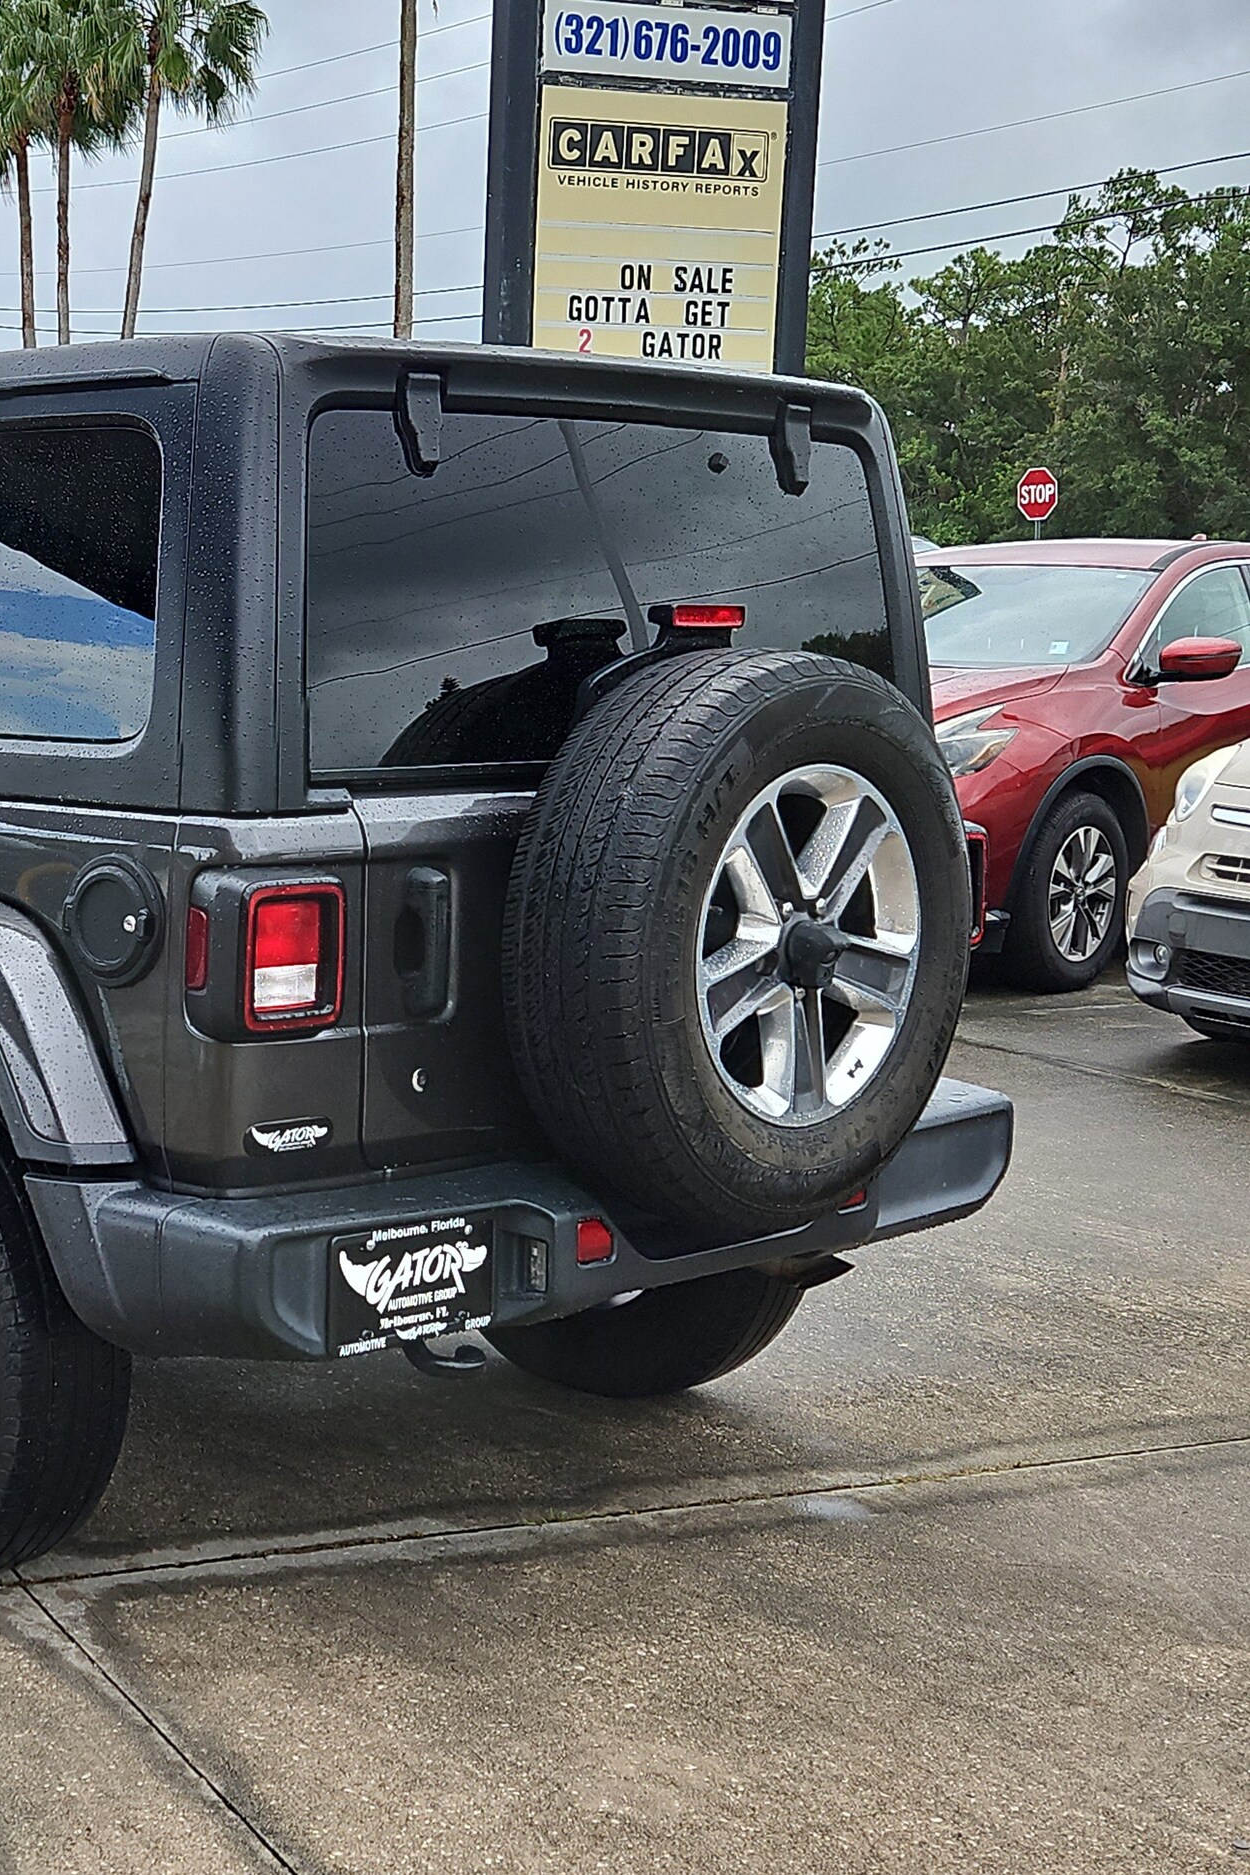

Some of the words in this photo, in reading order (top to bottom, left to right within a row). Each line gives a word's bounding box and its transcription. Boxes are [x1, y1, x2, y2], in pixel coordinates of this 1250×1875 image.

[554, 11, 782, 71] (321)676-2009
[558, 127, 761, 178] CARFAX
[557, 174, 619, 189] VEHICLE
[625, 178, 689, 193] HISTORY
[695, 183, 760, 197] REPORTS
[620, 264, 652, 291] ON
[673, 266, 734, 294] SALE
[568, 295, 651, 325] GOTTA
[684, 300, 731, 327] GET
[578, 328, 592, 354] 2
[642, 331, 722, 360] GATOR
[1020, 483, 1055, 505] STOP
[267, 1125, 317, 1153] GATOR
[431, 1217, 465, 1233] Florida
[365, 1242, 466, 1315] GATOR
[387, 1291, 433, 1312] AUTOMOTIVE
[433, 1286, 458, 1301] GROUP
[338, 1336, 387, 1357] AUTOMOTIVE
[464, 1315, 492, 1331] GROUP
